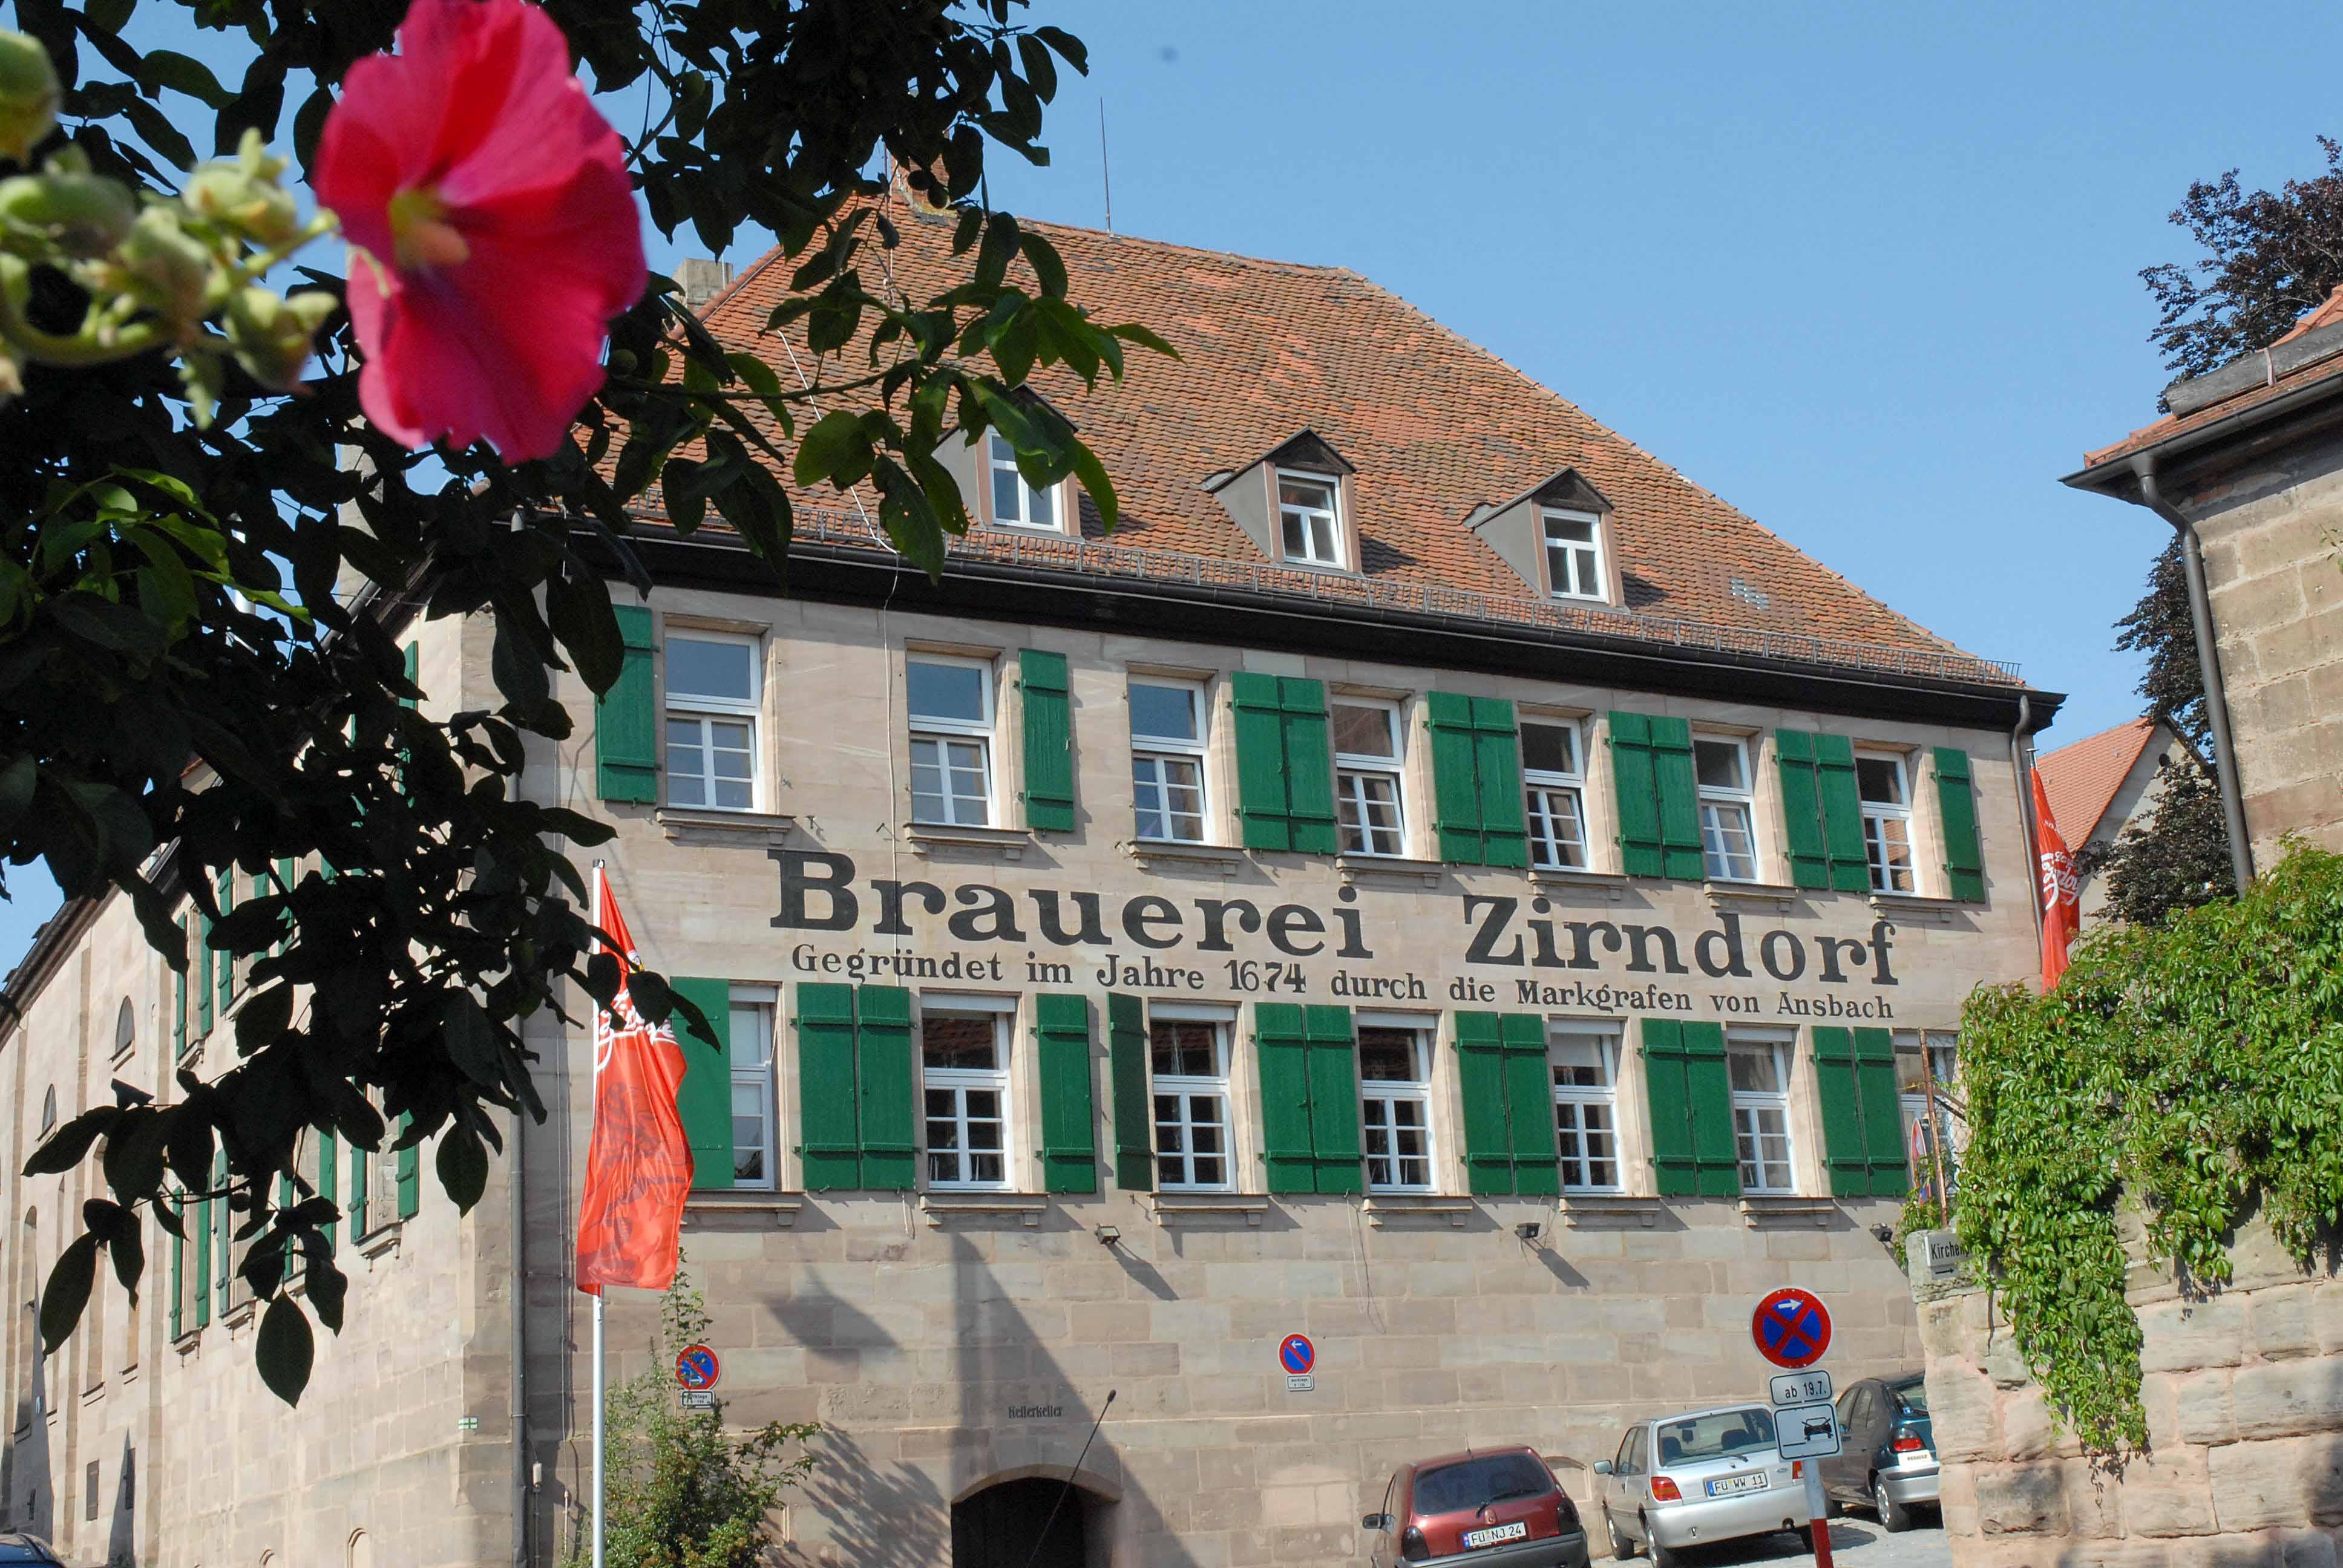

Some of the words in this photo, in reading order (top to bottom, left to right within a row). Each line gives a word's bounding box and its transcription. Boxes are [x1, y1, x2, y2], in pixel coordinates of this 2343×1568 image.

[767, 850, 1373, 958] Brauerei
[1463, 895, 1898, 985] Zirndorf
[792, 944, 1003, 983] Gegründet
[1026, 951, 1073, 983] im
[1096, 954, 1204, 990] Jahre
[1224, 959, 1306, 993] 1674
[1331, 970, 1427, 1000] durch
[1449, 976, 1495, 1002] die
[1515, 979, 1693, 1014] Markgrafen
[1709, 995, 1760, 1013] von
[1777, 991, 1893, 1018] Ansbach
[1785, 1385, 1797, 1398] ab
[1803, 1381, 1826, 1396] 19.7.
[1715, 1481, 1728, 1492] FÜ
[1733, 1478, 1746, 1488] WW
[1752, 1475, 1764, 1486] 11
[1471, 1532, 1485, 1543] FÜ
[1491, 1528, 1506, 1540] NJ
[1509, 1524, 1521, 1537] 24
